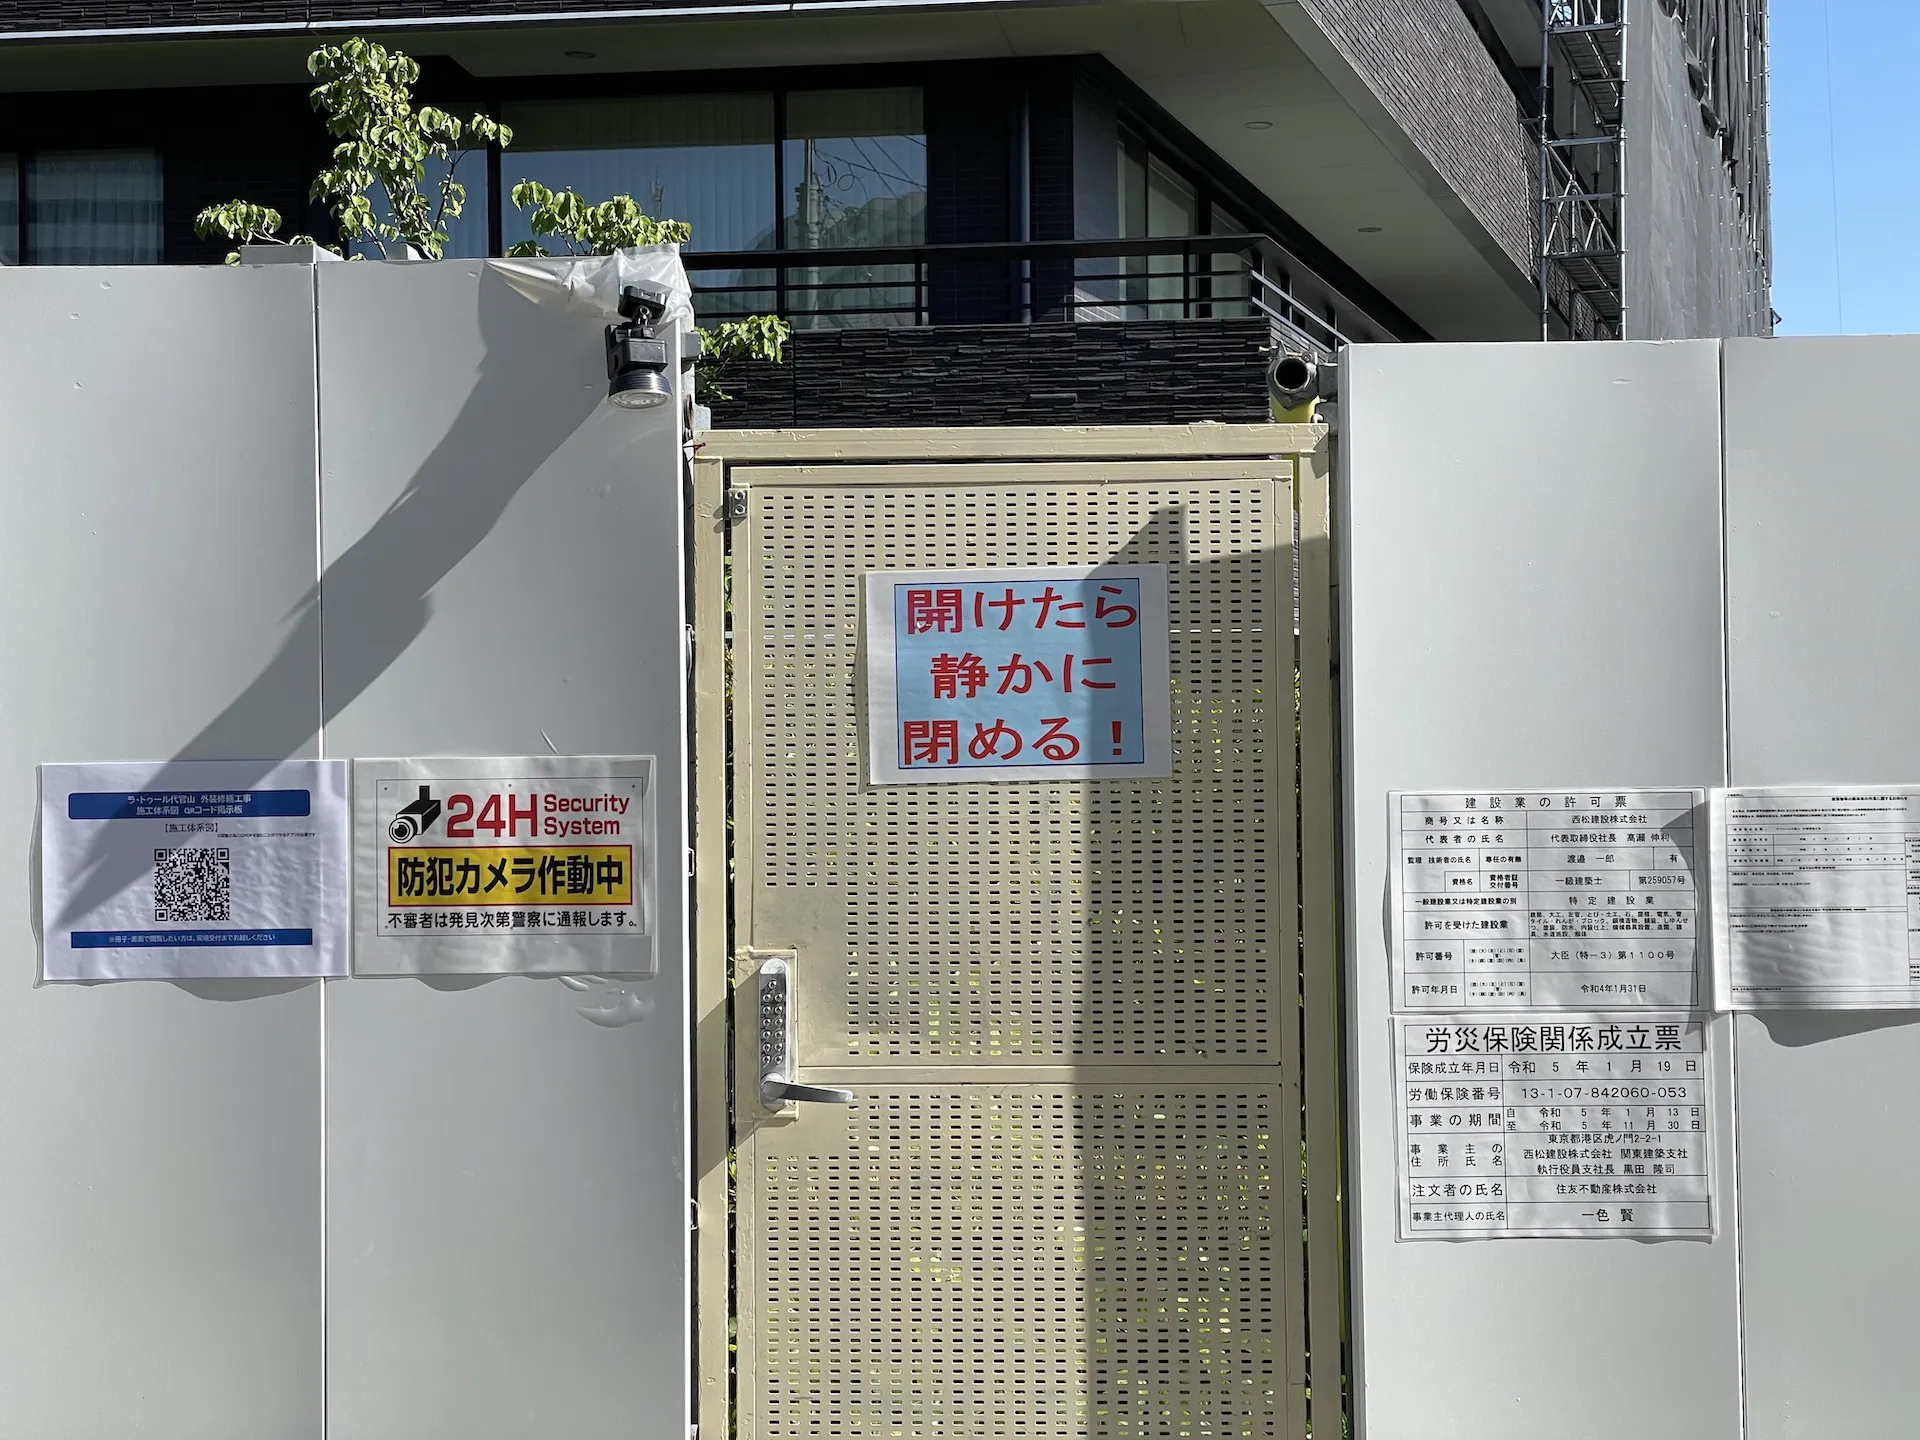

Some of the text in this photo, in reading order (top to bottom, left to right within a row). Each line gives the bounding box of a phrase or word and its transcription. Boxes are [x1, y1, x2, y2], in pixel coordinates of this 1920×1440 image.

[906, 585, 1138, 635] 開けたら
[929, 652, 1118, 700] 静かに
[447, 793, 630, 838] 24H Security
[1571, 815, 1647, 824] 西松建設株式会社
[544, 816, 620, 837] System
[1425, 834, 1504, 844] 代表者の氏名
[1551, 833, 1617, 843] 代表取締役社長
[1669, 853, 1678, 863] 有
[398, 854, 623, 897] 防犯カメラ作動中
[1556, 876, 1602, 886] 一級建築士
[1638, 875, 1685, 885] 第259057号
[1452, 877, 1473, 886] 資格名
[388, 911, 635, 929] 不審者は発見次第警察に通報します。
[1424, 919, 1508, 930] 許可を受けた建設業
[1416, 951, 1453, 961] 許可番号
[1412, 984, 1458, 994] 許可年月日
[1580, 983, 1646, 994] 令和4年1月31日
[1426, 1025, 1682, 1053] 労災保険関係成立票
[1408, 1062, 1500, 1074] 保険成立年月日
[1409, 1086, 1501, 1101] 労働保険番号
[1521, 1086, 1687, 1099] 13-1-07-842060-053
[1410, 1113, 1501, 1127] 事業の期間
[1523, 1148, 1688, 1159] 西松建設株式会社 関東建築支社
[1537, 1164, 1675, 1175] 執行役員支社長 黒田 隆司
[1412, 1184, 1503, 1197] 注文者の氏名
[1556, 1183, 1657, 1194] 住友不動産株式会社
[1412, 1211, 1505, 1222] 事業主代理人の氏名
[1582, 1209, 1634, 1222] 一色 賢
